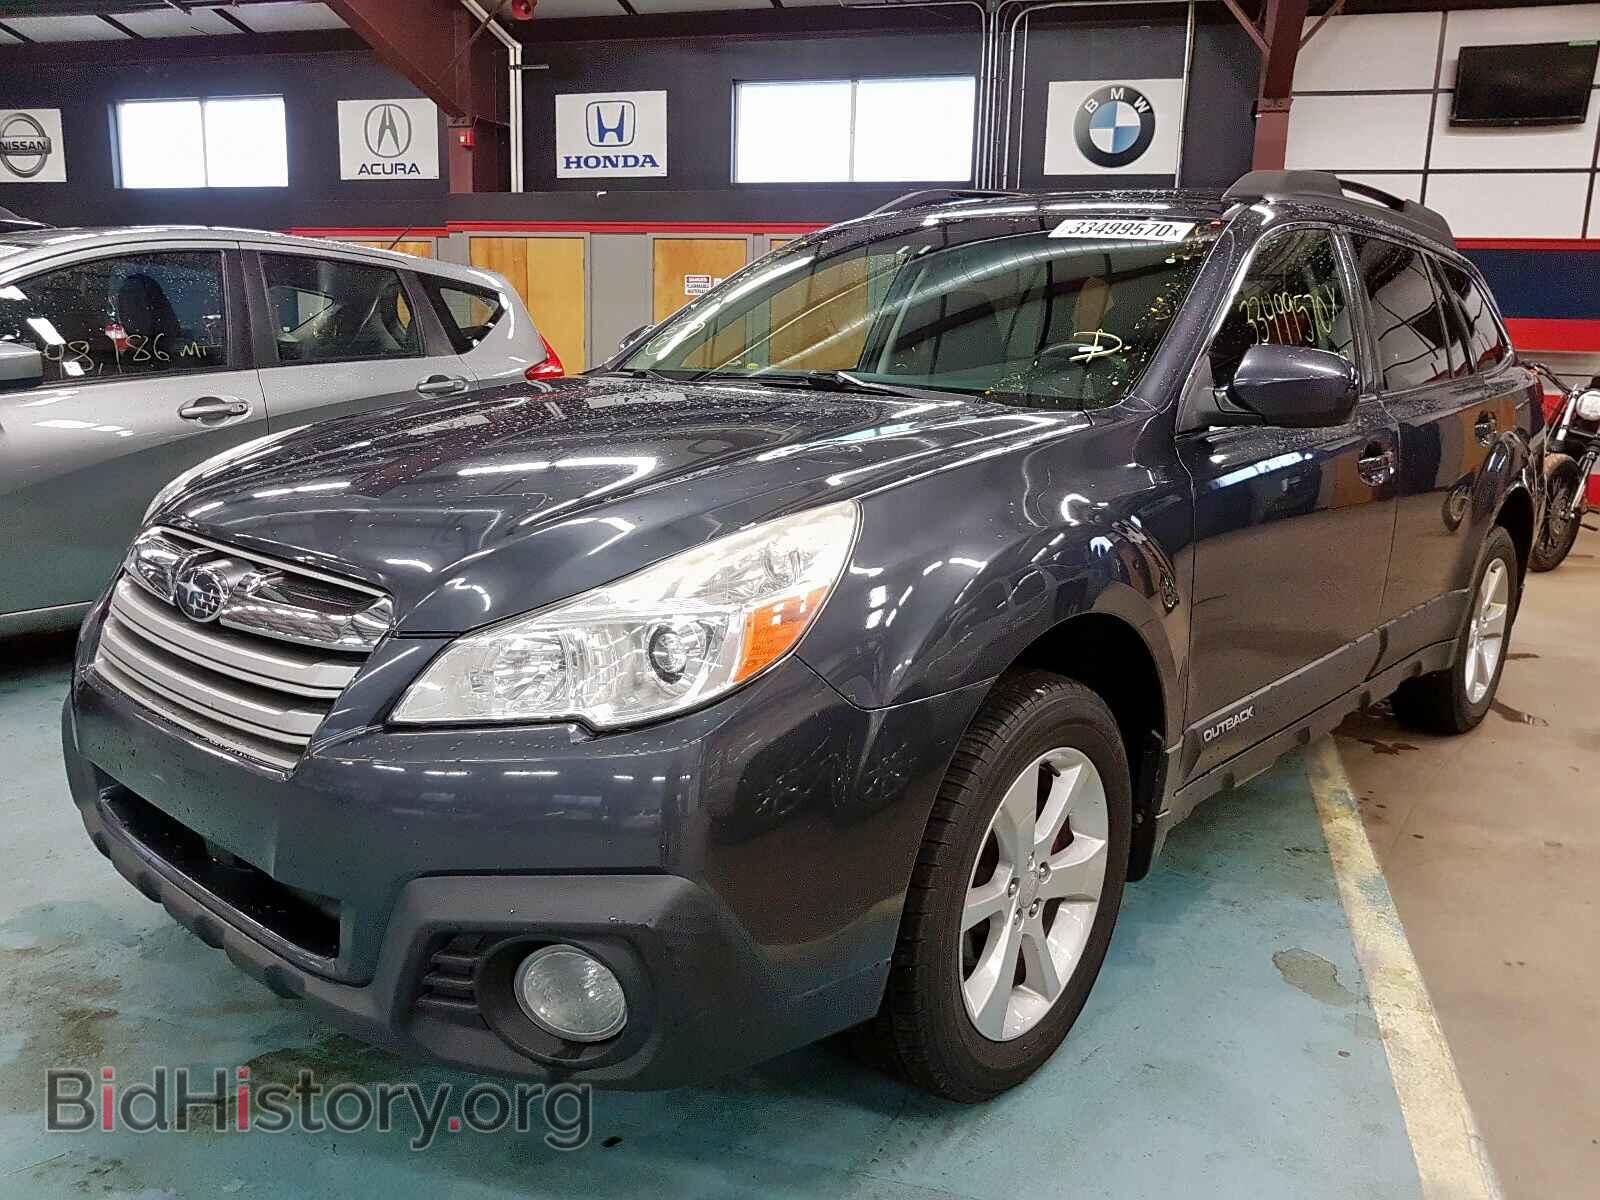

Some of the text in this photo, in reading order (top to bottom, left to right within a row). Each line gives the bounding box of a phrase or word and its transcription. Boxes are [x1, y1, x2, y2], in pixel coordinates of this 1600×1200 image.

[1084, 87, 1150, 114] BMW
[0, 140, 46, 151] NISSAN
[358, 162, 421, 175] ACURA
[563, 154, 660, 169] HONDA
[1204, 706, 1254, 742] OUTBACK
